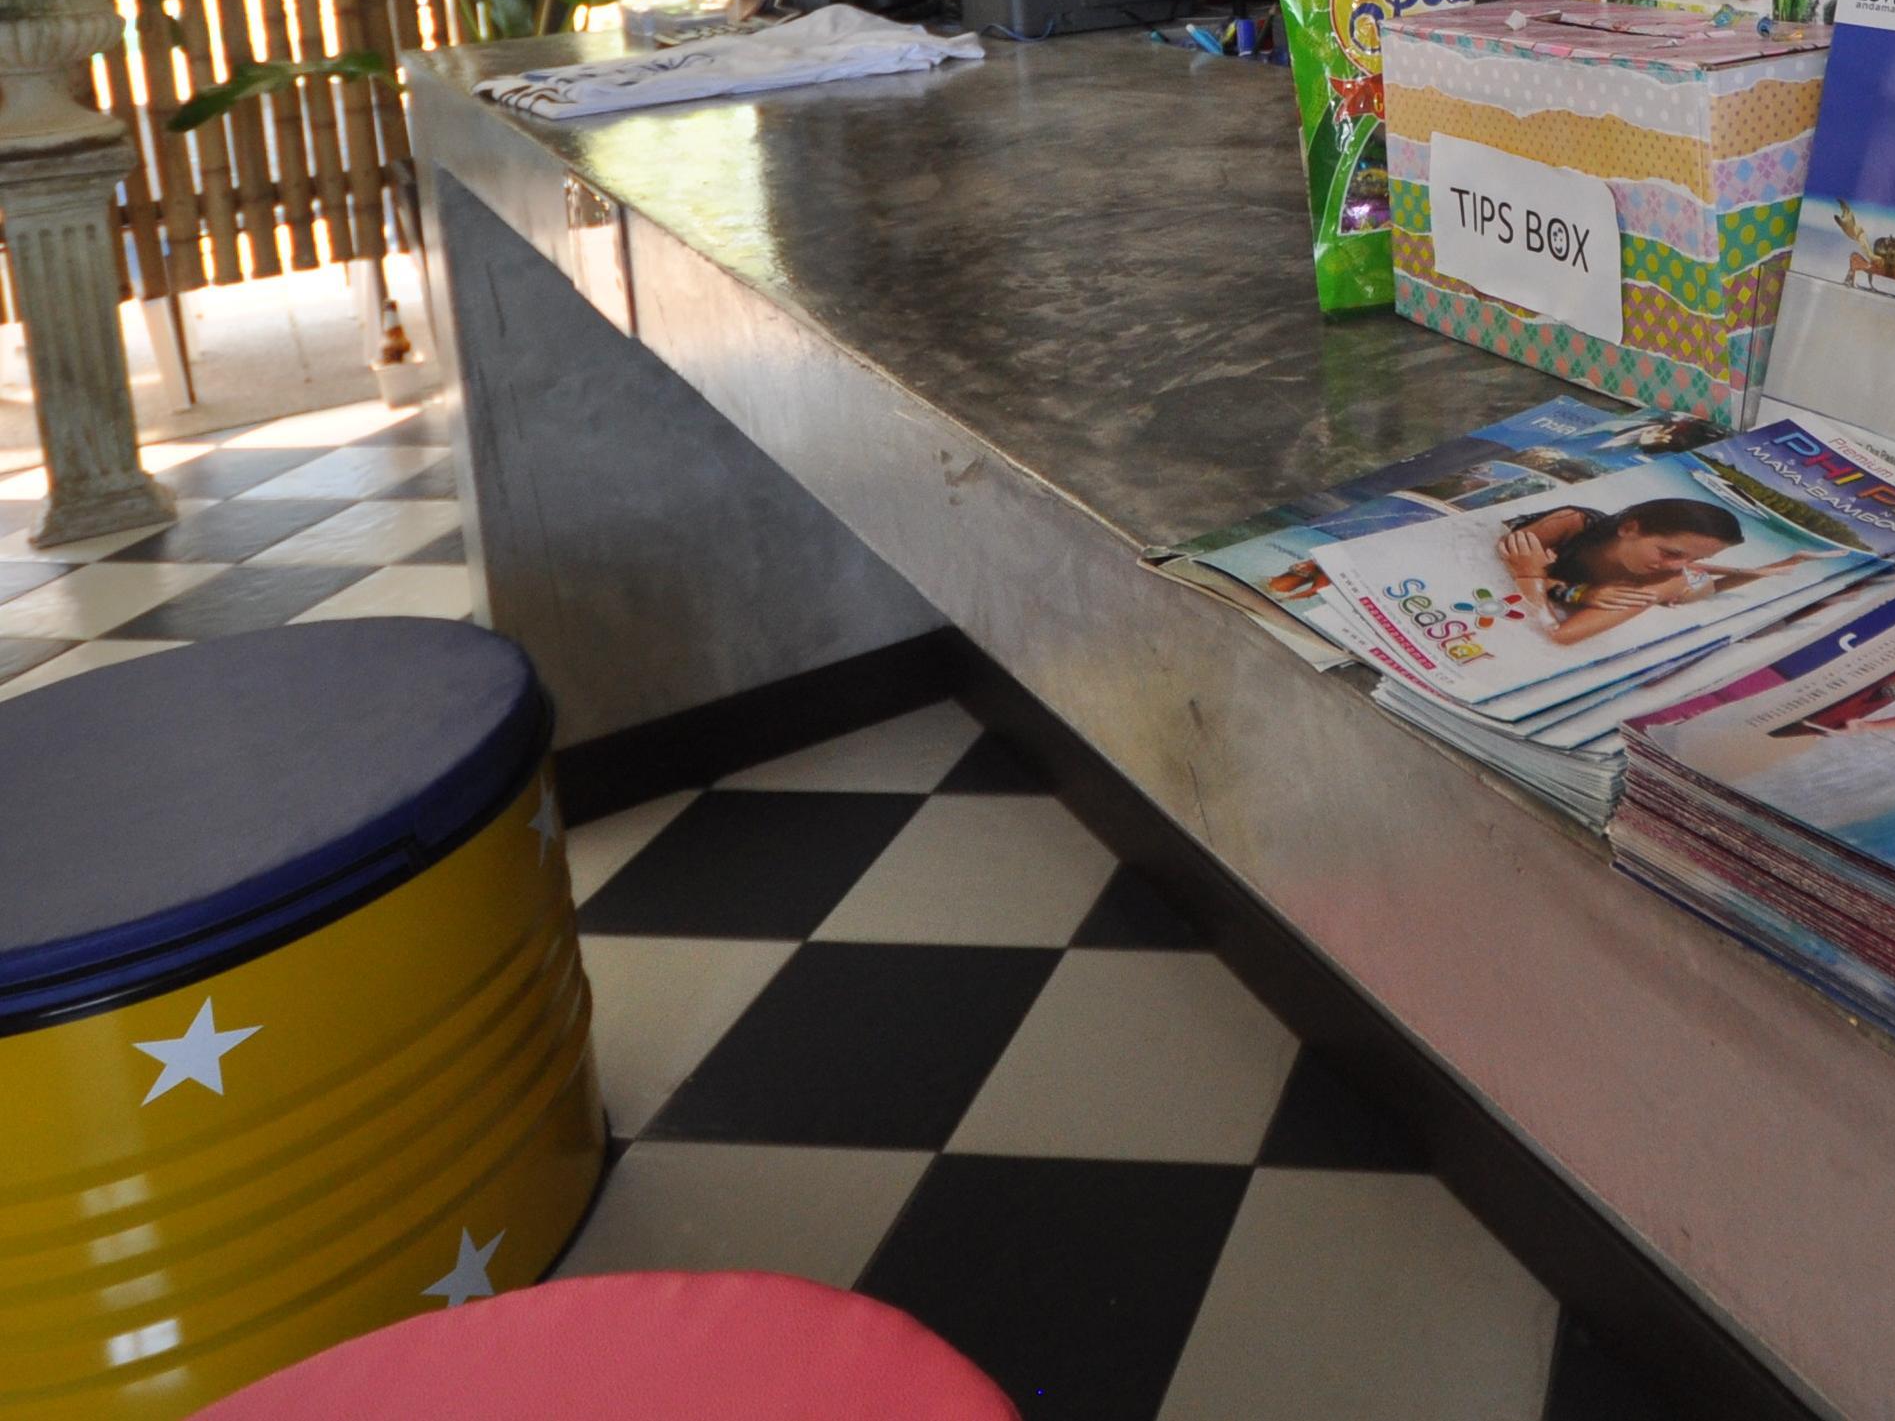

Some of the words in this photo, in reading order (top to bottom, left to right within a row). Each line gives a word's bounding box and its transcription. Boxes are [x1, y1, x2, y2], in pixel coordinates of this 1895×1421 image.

[1450, 187, 1514, 244] TIPS
[1526, 210, 1590, 273] BOX
[1771, 432, 1864, 485] PHI
[1829, 437, 1893, 479] Premium
